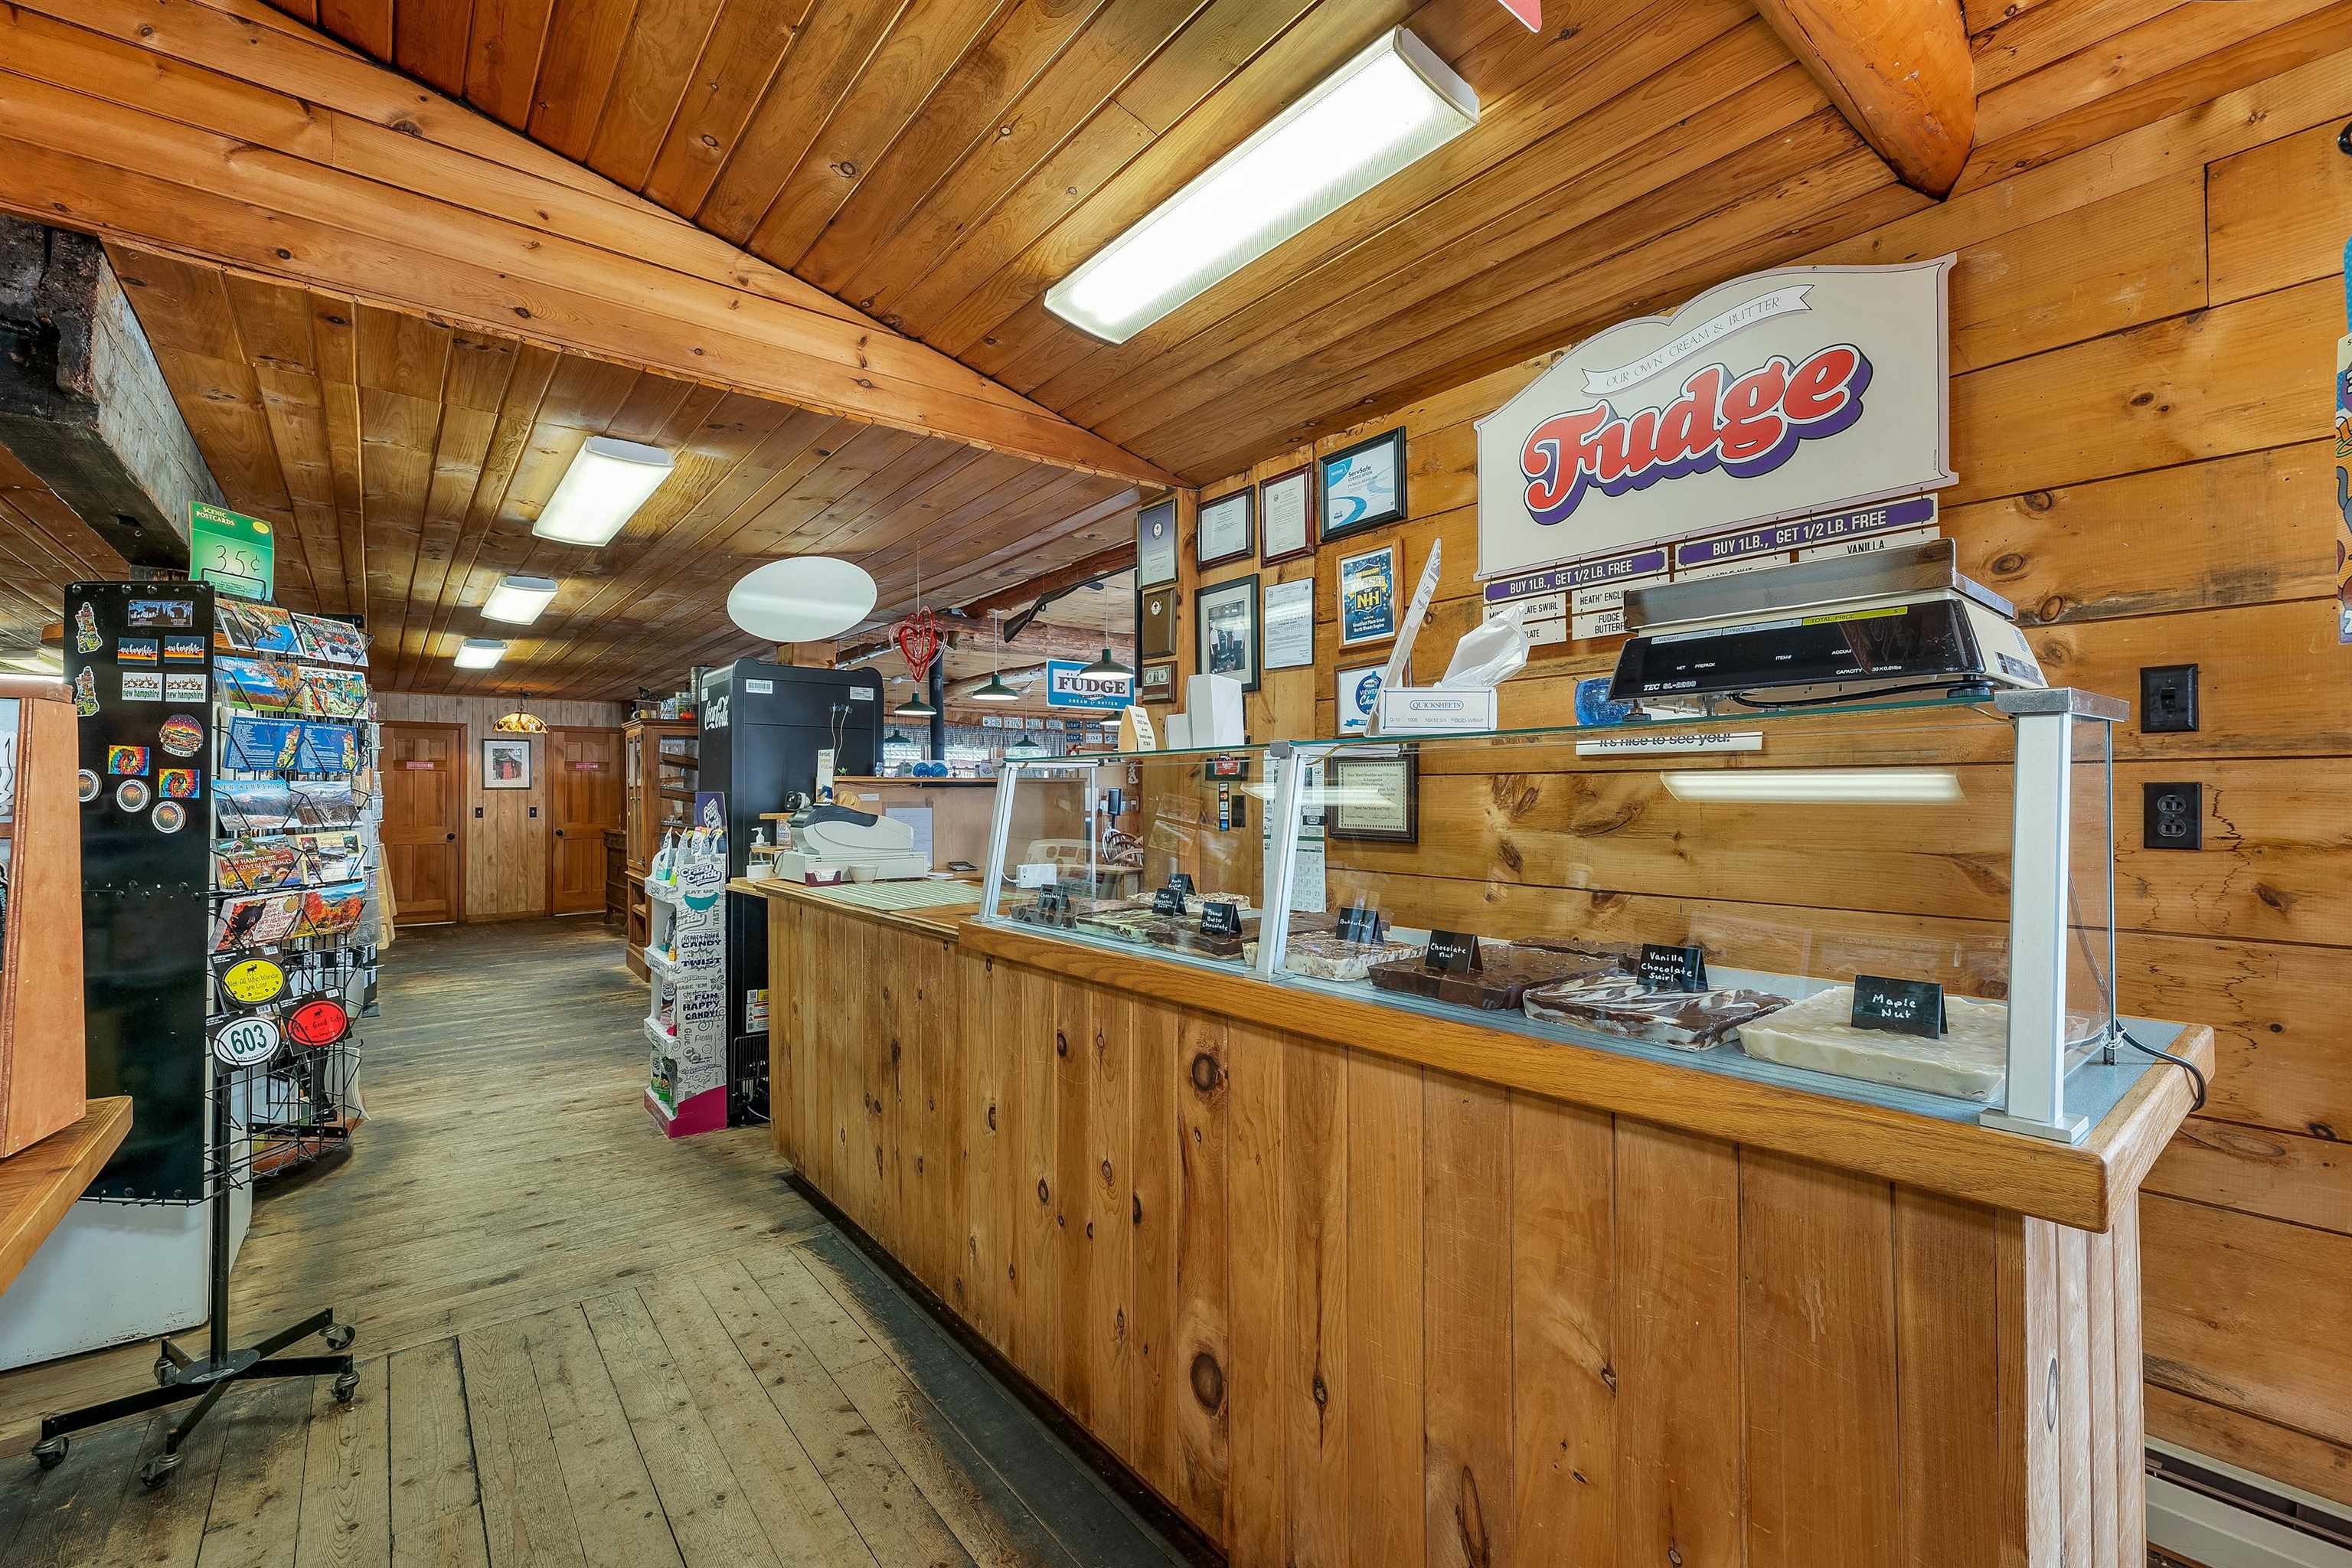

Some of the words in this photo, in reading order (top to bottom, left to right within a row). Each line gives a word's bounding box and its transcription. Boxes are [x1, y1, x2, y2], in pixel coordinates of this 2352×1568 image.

[1606, 371, 1629, 387] OUR
[1634, 355, 1662, 376] OWN
[1669, 329, 1710, 357] CREAM
[1713, 324, 1724, 334] &
[1729, 296, 1780, 325] BUTTER
[1521, 345, 1868, 519] Fudge
[1348, 465, 1371, 477] ServSafe
[196, 511, 235, 526] POSTCARDS
[202, 507, 227, 518] SCENIC
[1713, 540, 1735, 557] BUY
[1776, 527, 1799, 544] GET
[1803, 522, 1824, 540] 1/2
[1828, 519, 1848, 534] LB.
[1851, 510, 1886, 529] FREE
[1847, 539, 1885, 555] VANILLA
[1510, 581, 1526, 594] BUY
[1555, 572, 1570, 586] GET
[1574, 570, 1589, 583] 1/2
[1592, 566, 1606, 578] LB.
[1608, 560, 1632, 575] FREE
[1357, 590, 1380, 609] NH
[1538, 603, 1558, 613] SWIRL
[1599, 613, 1620, 623] FUDGE
[1057, 676, 1126, 694] FUDGE
[1643, 683, 1661, 691] TEC
[122, 689, 134, 698] new
[134, 687, 160, 699] hampshire
[166, 691, 177, 699] new
[177, 690, 204, 700] hampshire
[1621, 737, 1648, 746] nice
[1652, 736, 1665, 746] to
[1668, 733, 1694, 744] see
[1698, 733, 1731, 746] you!
[240, 854, 277, 864] HAMPSHIRE
[240, 862, 266, 871] COVERED
[268, 858, 292, 867] BRIDGES
[681, 864, 713, 877] Crazy
[687, 871, 720, 883] Candy
[1207, 909, 1223, 917] Peanut
[1202, 922, 1229, 932] Chocolate
[681, 939, 721, 948] CANDY
[1430, 942, 1466, 955] Chocolate
[681, 957, 721, 966] TWIST
[1649, 952, 1684, 962] Vanilla
[1641, 962, 1693, 978] Chocolate
[694, 992, 718, 1001] FUN
[1872, 994, 1916, 1008] Maple
[683, 1000, 720, 1011] HAPPY
[685, 1010, 718, 1020] CANDY!
[1881, 1009, 1911, 1019] Nut
[312, 1018, 328, 1028] Good
[231, 1024, 267, 1055] 603
